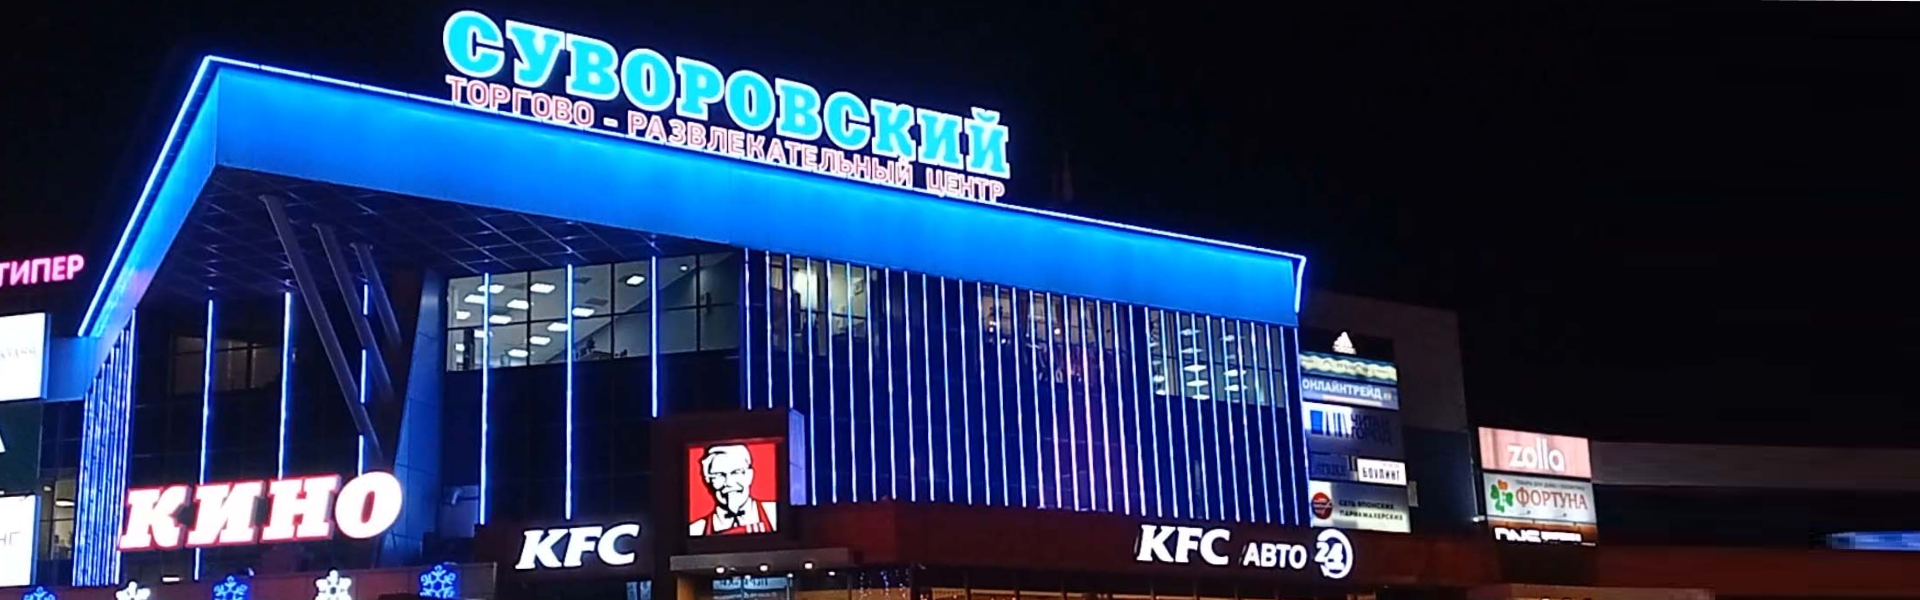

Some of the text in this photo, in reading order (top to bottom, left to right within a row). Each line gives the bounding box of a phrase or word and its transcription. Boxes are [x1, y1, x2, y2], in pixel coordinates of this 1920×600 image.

[443, 10, 1010, 179] СУВОРОВСКИЙ
[445, 75, 595, 128] ТОРГОВО
[627, 110, 914, 188] РАЗВЛЕКАТЕЛЬНЫЙ
[926, 167, 1005, 202] ЦЕНТР
[1507, 437, 1566, 471] zolla
[118, 471, 402, 551] КИНО
[1515, 487, 1588, 510] ФОРТУНА
[514, 524, 640, 570] KFC
[1135, 524, 1231, 566] KFC
[1242, 542, 1307, 569] АВТО
